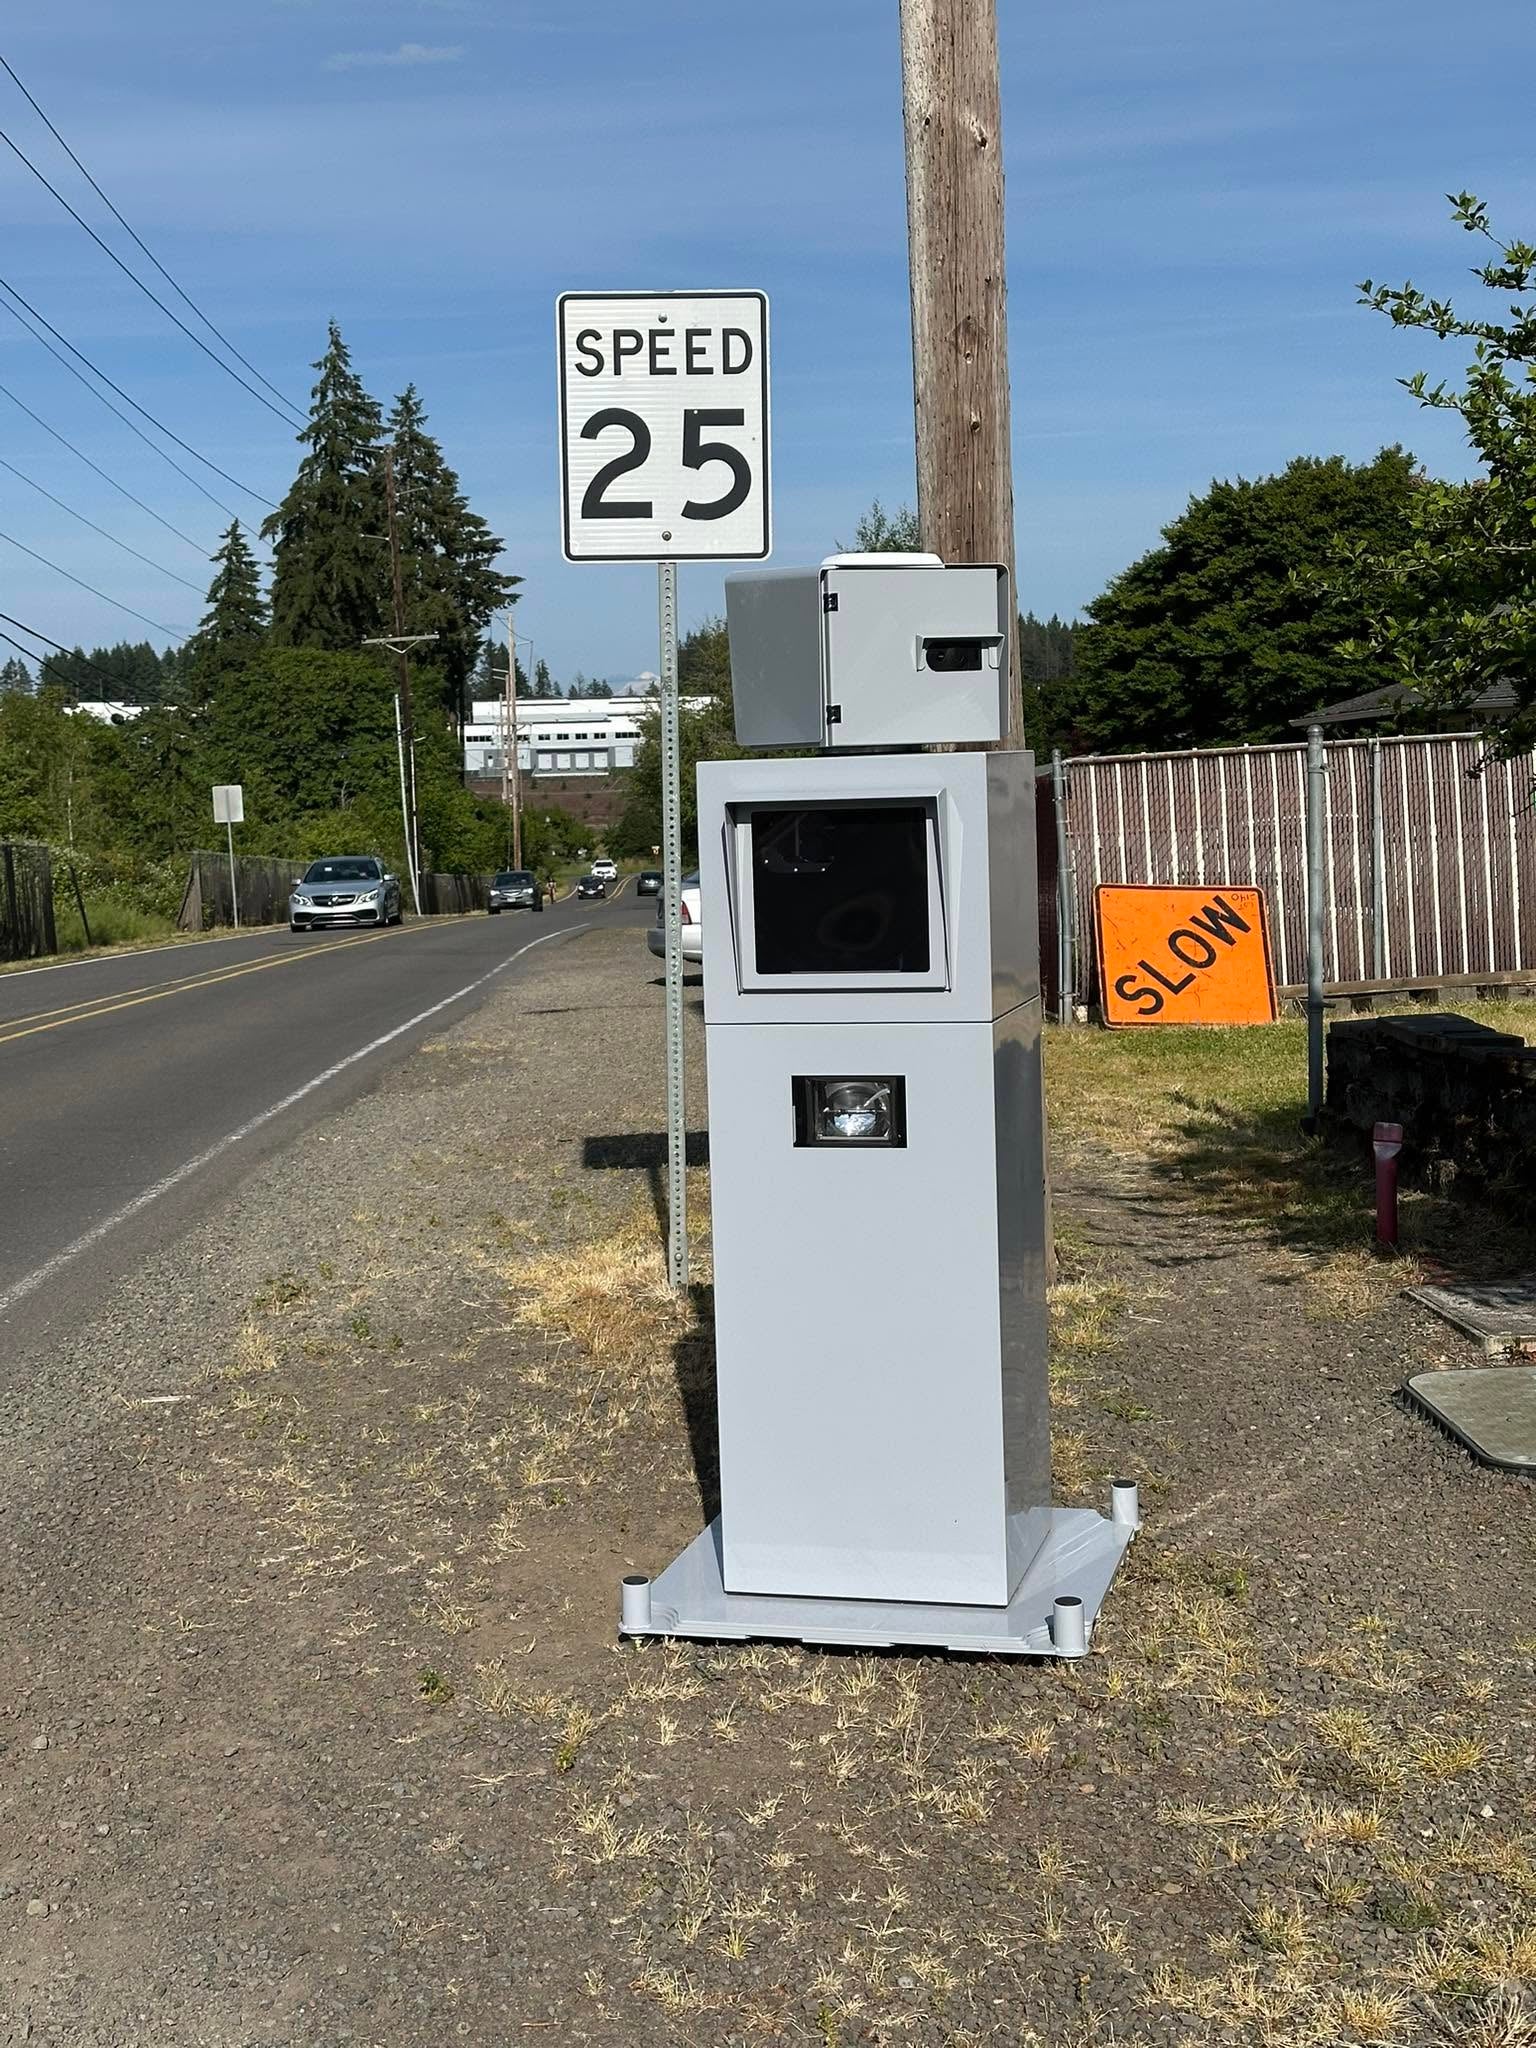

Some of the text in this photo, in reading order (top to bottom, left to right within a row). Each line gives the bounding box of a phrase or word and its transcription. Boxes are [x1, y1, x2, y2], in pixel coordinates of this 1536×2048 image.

[575, 328, 753, 377] SPEED
[580, 407, 752, 521] 25
[1115, 895, 1251, 1015] SLOW
